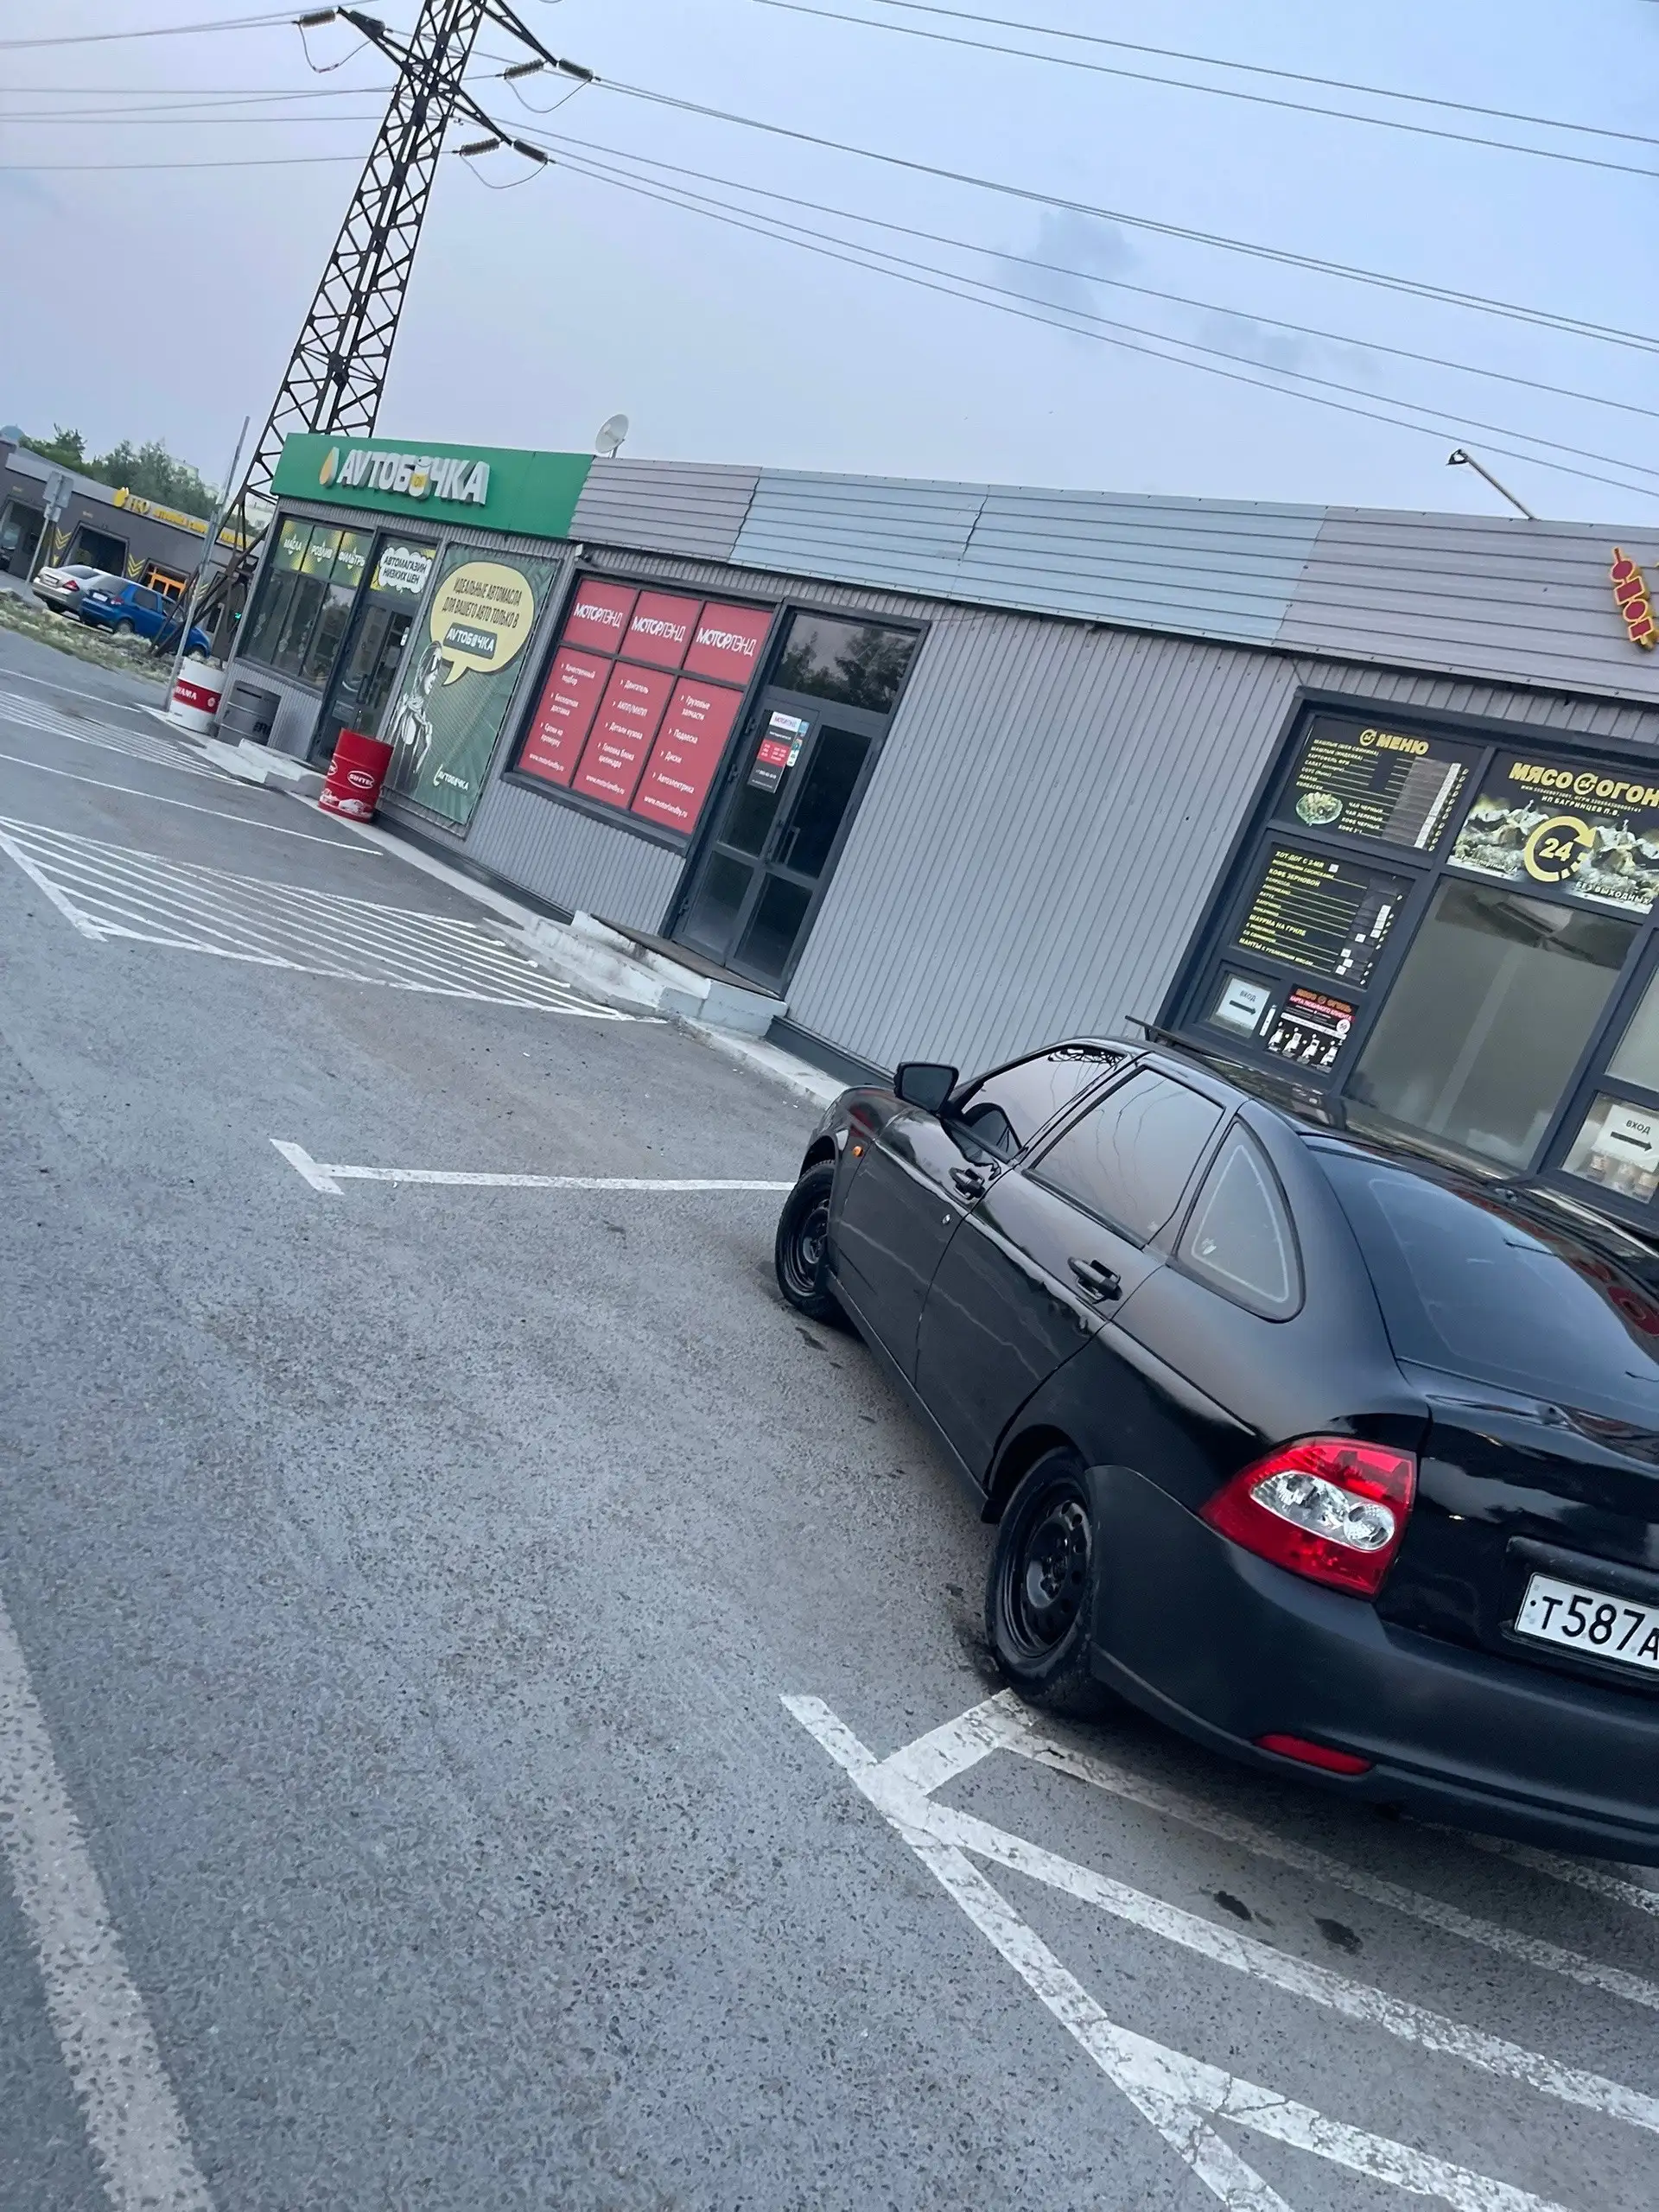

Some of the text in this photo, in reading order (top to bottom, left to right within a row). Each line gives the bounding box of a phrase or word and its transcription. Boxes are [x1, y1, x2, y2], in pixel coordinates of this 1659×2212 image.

[383, 556, 428, 575] АВТОМАГАЗИН
[382, 569, 421, 585] НИЗКИХ ЦЕН
[453, 576, 522, 606] ИДЕАЛЬНЫЕ АВТОМАСЛА
[442, 596, 520, 629] ДЛЯ ВАШЕГО АВТО ТОЛЬКО В
[574, 602, 624, 628] МОТОРЛЭНД
[631, 616, 687, 643] МОТОРЛЭНД
[696, 627, 757, 657] МОТОРЛЭНД
[624, 680, 648, 695] Двигатель
[685, 696, 710, 710] Грузовые
[682, 708, 705, 721] запчасти
[608, 721, 643, 741] Детали кузова
[673, 728, 698, 744] Подвеска
[602, 742, 635, 761] Головка блока
[1376, 734, 1429, 755] МЕНЮ
[664, 751, 683, 764] Диски
[656, 772, 695, 794] Автоэлектрика
[1509, 761, 1573, 790] МЯСО
[1595, 779, 1659, 810] ОГОН
[1360, 804, 1382, 813] ЧЕРНЫЙ
[1541, 795, 1554, 804] ИП
[1554, 798, 1601, 814] БАГРИНЦЕВ
[1357, 812, 1382, 822] ЗЕЛЕНЫЙ
[1538, 837, 1574, 862] 24
[1268, 868, 1286, 877] КОФЕ
[1575, 880, 1652, 906] БЕЗ ВЫХОДНЫХ
[1249, 914, 1275, 926] ШАУРМА
[1239, 989, 1257, 1003] ВХОД
[1625, 1119, 1651, 1135] ВХОД
[1541, 1594, 1659, 1661] Т587А
